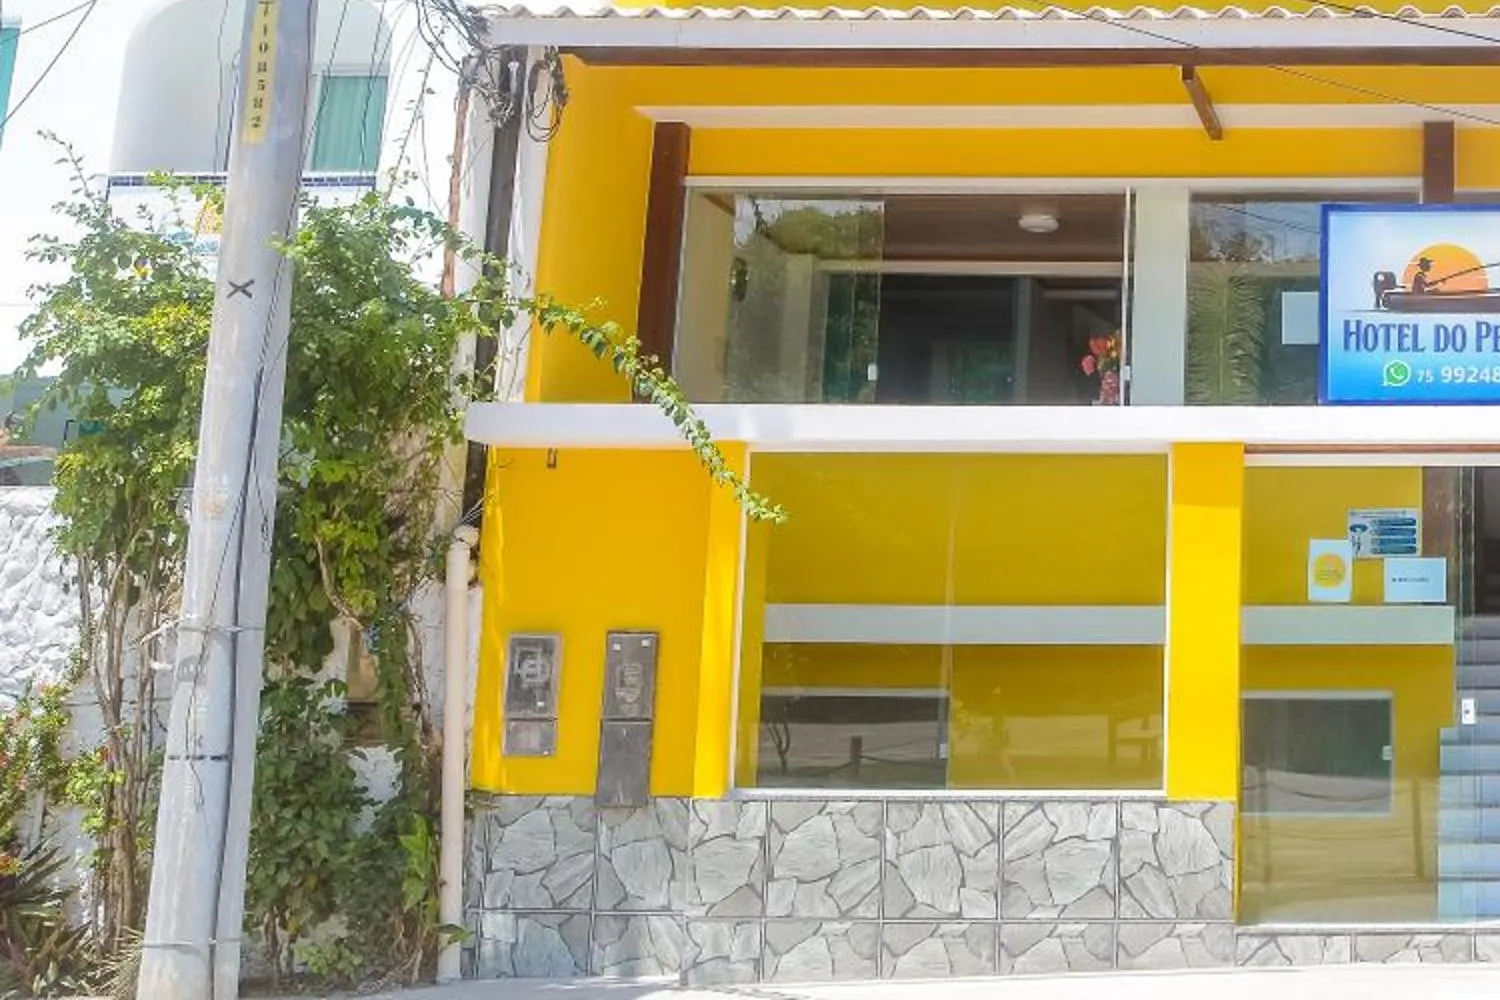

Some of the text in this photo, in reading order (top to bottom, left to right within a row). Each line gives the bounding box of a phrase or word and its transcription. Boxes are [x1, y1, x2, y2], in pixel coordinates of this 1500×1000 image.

[1342, 319, 1426, 353] HOTEL
[1433, 323, 1467, 353] DO
[1416, 368, 1434, 384] 75
